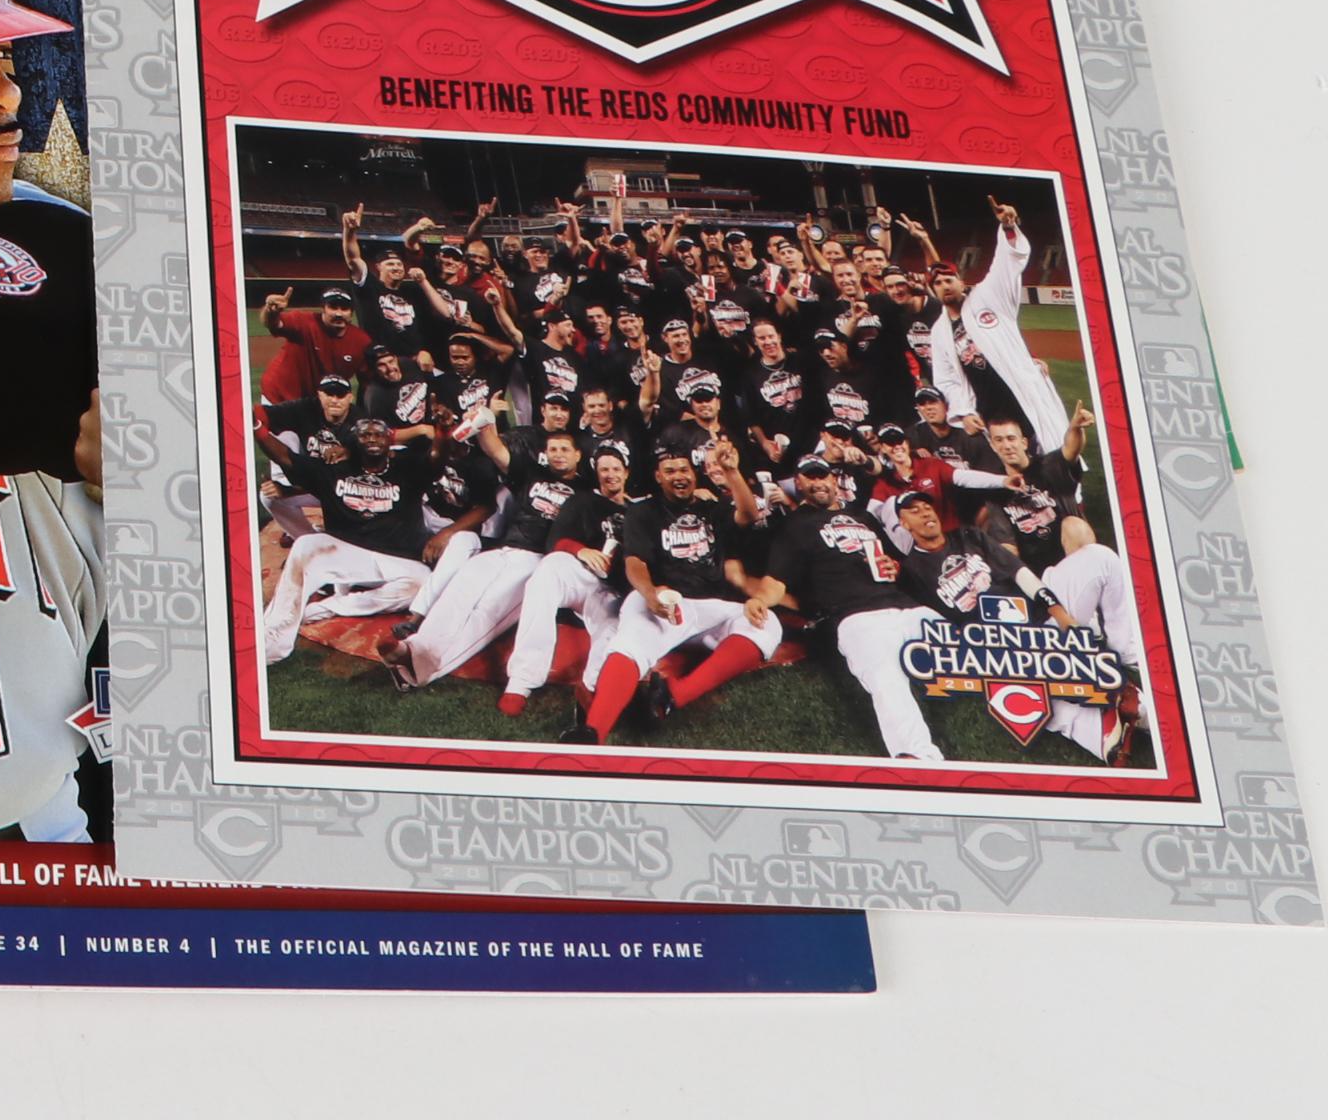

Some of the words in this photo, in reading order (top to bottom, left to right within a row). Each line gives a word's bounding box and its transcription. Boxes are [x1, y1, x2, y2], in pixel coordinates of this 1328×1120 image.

[379, 76, 534, 114] BENEFITING
[544, 83, 592, 118] THE
[600, 86, 669, 122] REDS
[677, 91, 834, 134] COMMUNITY
[842, 107, 911, 139] FUND
[922, 619, 958, 646] NL
[963, 623, 1102, 655] CENTRAL
[901, 640, 1124, 691] CHAMPIONS
[466, 796, 644, 830] CENTRAL
[389, 816, 670, 876] CHAMPIONS
[34, 864, 66, 887] OF
[15, 935, 40, 952] 34
[86, 937, 172, 954] NUMBER
[178, 938, 191, 954] 4
[235, 939, 272, 955] THE
[280, 939, 370, 956] OFFICIAL
[378, 939, 480, 957] MAGAZINE
[488, 940, 512, 957] OF
[519, 940, 555, 957] THE
[562, 941, 612, 958] HALL
[620, 941, 644, 958] OF
[652, 941, 704, 959] FAME
